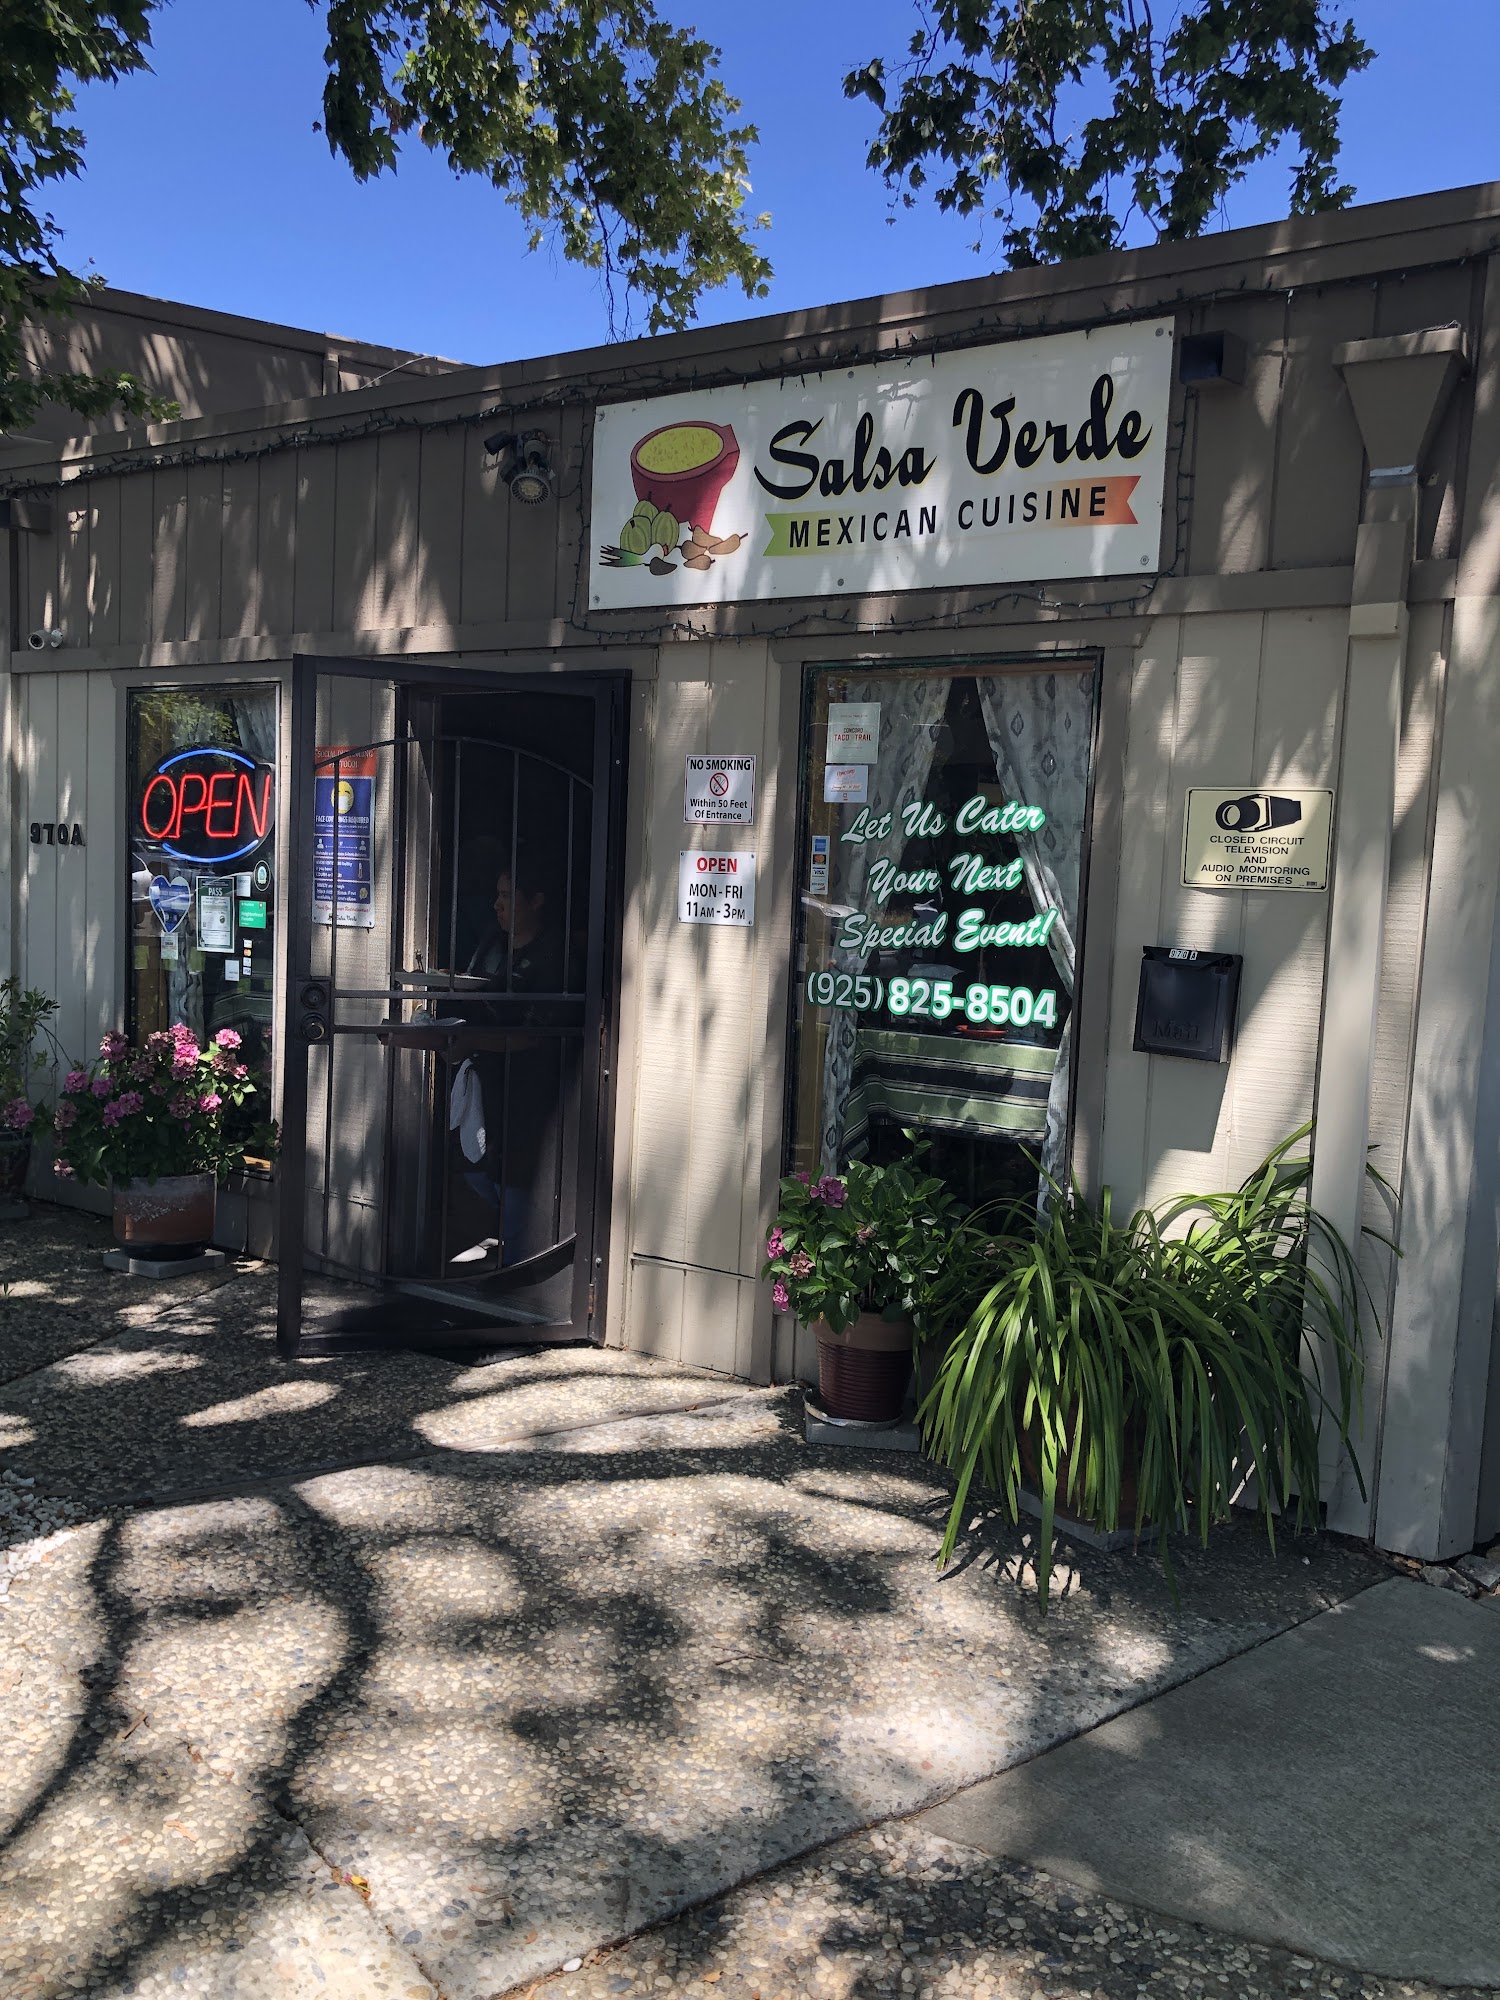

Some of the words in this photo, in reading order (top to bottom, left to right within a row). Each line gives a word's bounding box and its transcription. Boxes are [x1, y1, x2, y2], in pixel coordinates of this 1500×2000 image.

[753, 412, 938, 500] Salsa
[952, 373, 1153, 475] Verde
[789, 505, 937, 548] MEXICAN
[957, 486, 1106, 530] CUISINE
[690, 759, 704, 770] NO
[706, 759, 751, 771] SMOKING
[142, 773, 271, 839] OPEN
[690, 798, 716, 808] Within
[718, 800, 728, 808] 50
[730, 800, 748, 809] Feet
[694, 810, 705, 819] Of
[706, 810, 742, 820] Entrance
[840, 805, 893, 843] Let
[901, 801, 947, 839] Us
[955, 795, 1046, 834] Cater
[1210, 836, 1255, 844] CLOSED
[1260, 836, 1304, 845] CIRCUIT
[1224, 846, 1288, 855] TELEVISION
[696, 857, 738, 873] OPEN
[1244, 856, 1267, 864] AND
[1200, 864, 1234, 872] AUDIO
[1239, 866, 1310, 876] MONITORING
[869, 858, 941, 904] Your
[949, 852, 1024, 893] Next
[1215, 874, 1231, 882] ON
[1236, 875, 1293, 885] PREMISES
[208, 888, 222, 896] PASS
[689, 883, 717, 898] MON
[725, 885, 743, 899] FRI
[839, 911, 948, 959] Special
[954, 907, 1059, 952] Event!
[806, 971, 884, 1011] (925)
[888, 977, 1056, 1029] 825-8504
